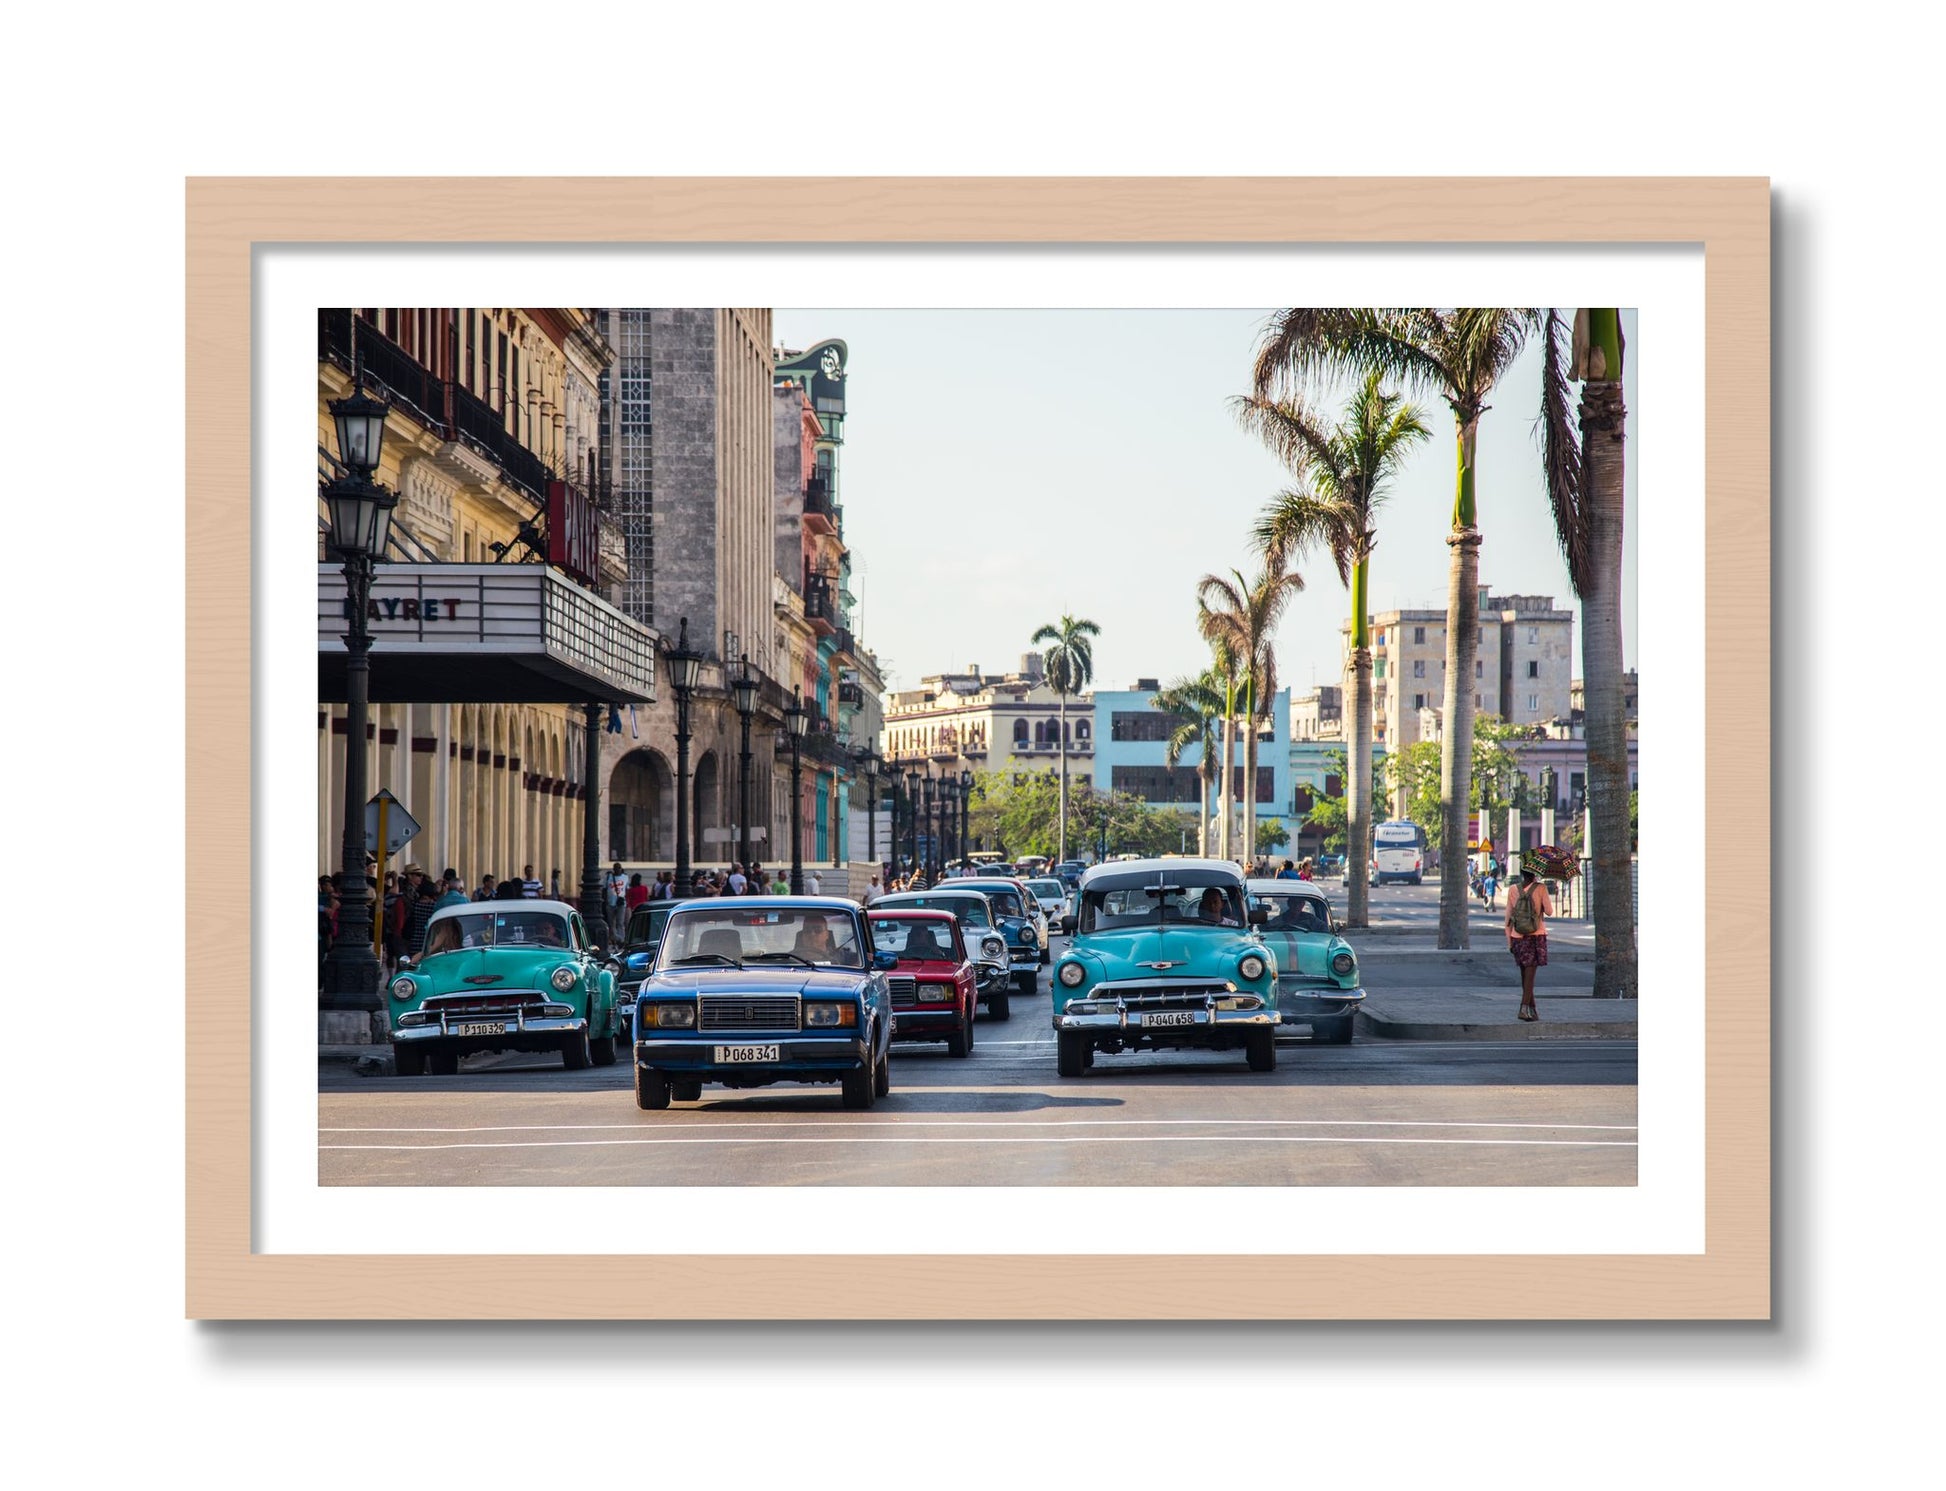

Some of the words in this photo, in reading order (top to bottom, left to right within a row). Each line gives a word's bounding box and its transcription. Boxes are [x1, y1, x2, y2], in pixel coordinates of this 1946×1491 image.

[471, 1025, 487, 1035] 110
[488, 1023, 504, 1034] 329
[732, 1048, 754, 1061] 068
[756, 1046, 777, 1060] 341
